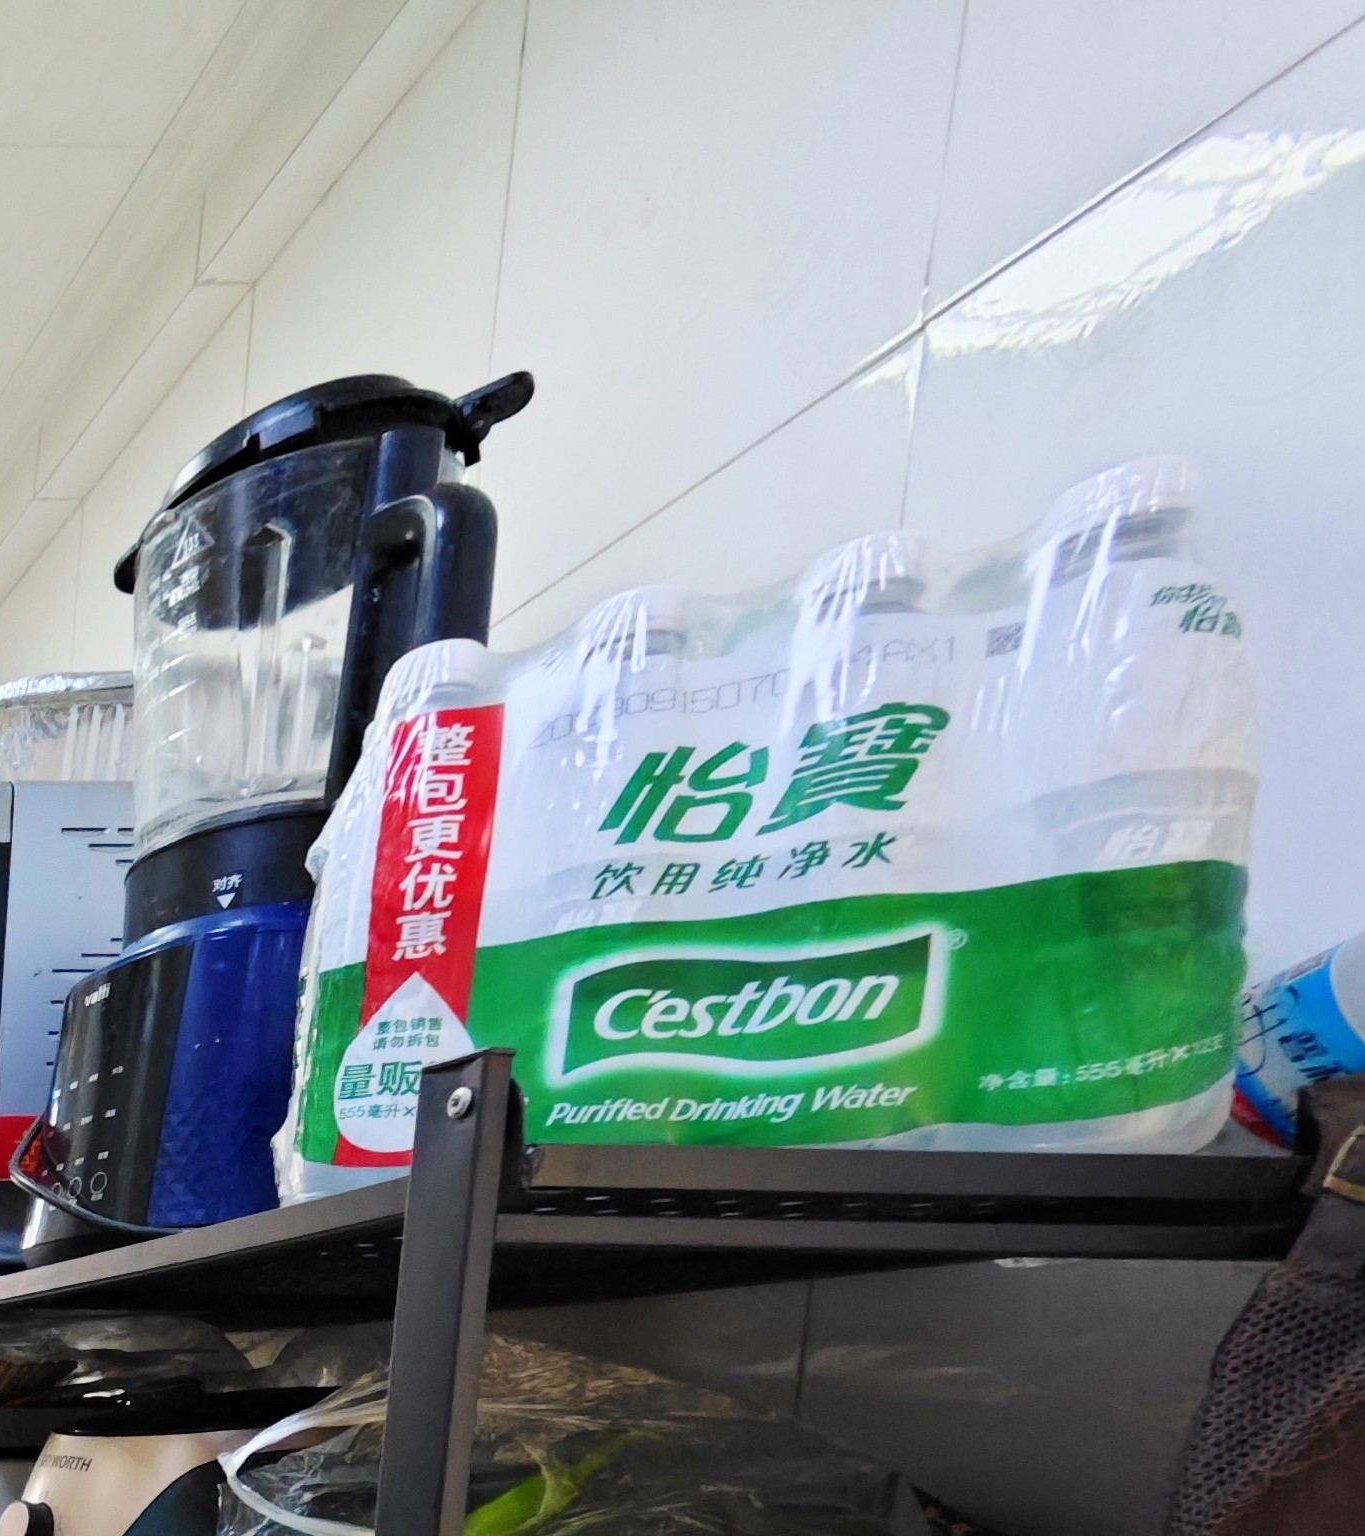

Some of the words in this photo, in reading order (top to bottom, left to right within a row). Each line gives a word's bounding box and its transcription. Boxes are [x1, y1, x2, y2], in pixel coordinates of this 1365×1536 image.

[598, 701, 951, 845] 怡寶
[391, 723, 475, 962] 整包更优惠
[589, 833, 897, 900] 饮用纯净水
[212, 873, 243, 892] 对齐
[376, 1017, 443, 1035] 整包销售
[593, 975, 899, 1040] C'estbon
[373, 1033, 440, 1050] 请勿拆包
[546, 1098, 667, 1126] Purified
[669, 1091, 802, 1122] Drinking
[810, 1083, 917, 1110] Water
